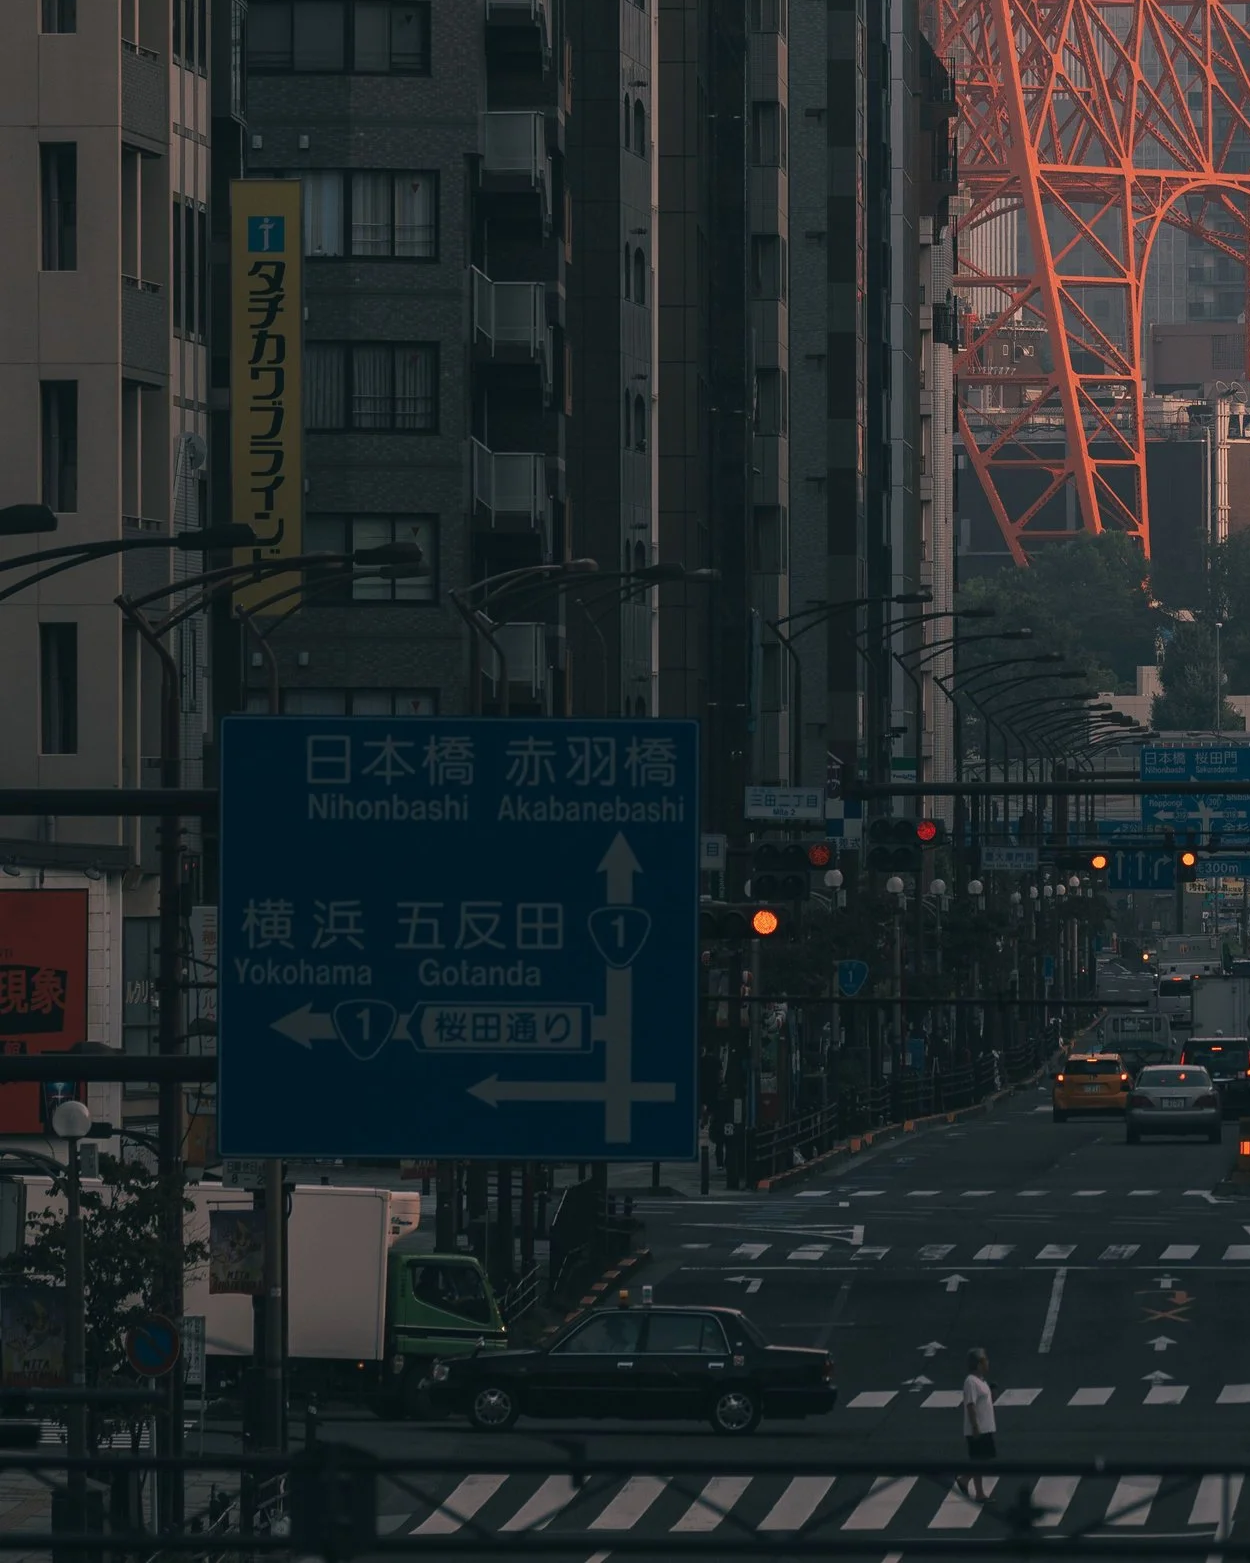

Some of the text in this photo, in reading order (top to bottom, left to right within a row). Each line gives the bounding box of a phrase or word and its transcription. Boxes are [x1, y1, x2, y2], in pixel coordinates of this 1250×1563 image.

[247, 260, 287, 579] タチカワブラインド
[306, 734, 677, 786] 日本橋 赤羽橋
[1145, 750, 1238, 765] 日本橋 桜田門
[307, 792, 685, 823] Nihonbashi Akabanebashi
[750, 794, 818, 807] 三田二丁目
[241, 898, 563, 951] 横浜 五反田
[612, 915, 625, 948] 1
[234, 957, 541, 987] Yokohama Gotanda
[847, 967, 853, 983] 1
[357, 1008, 370, 1039] 1
[435, 1011, 573, 1043] 桜田通り
